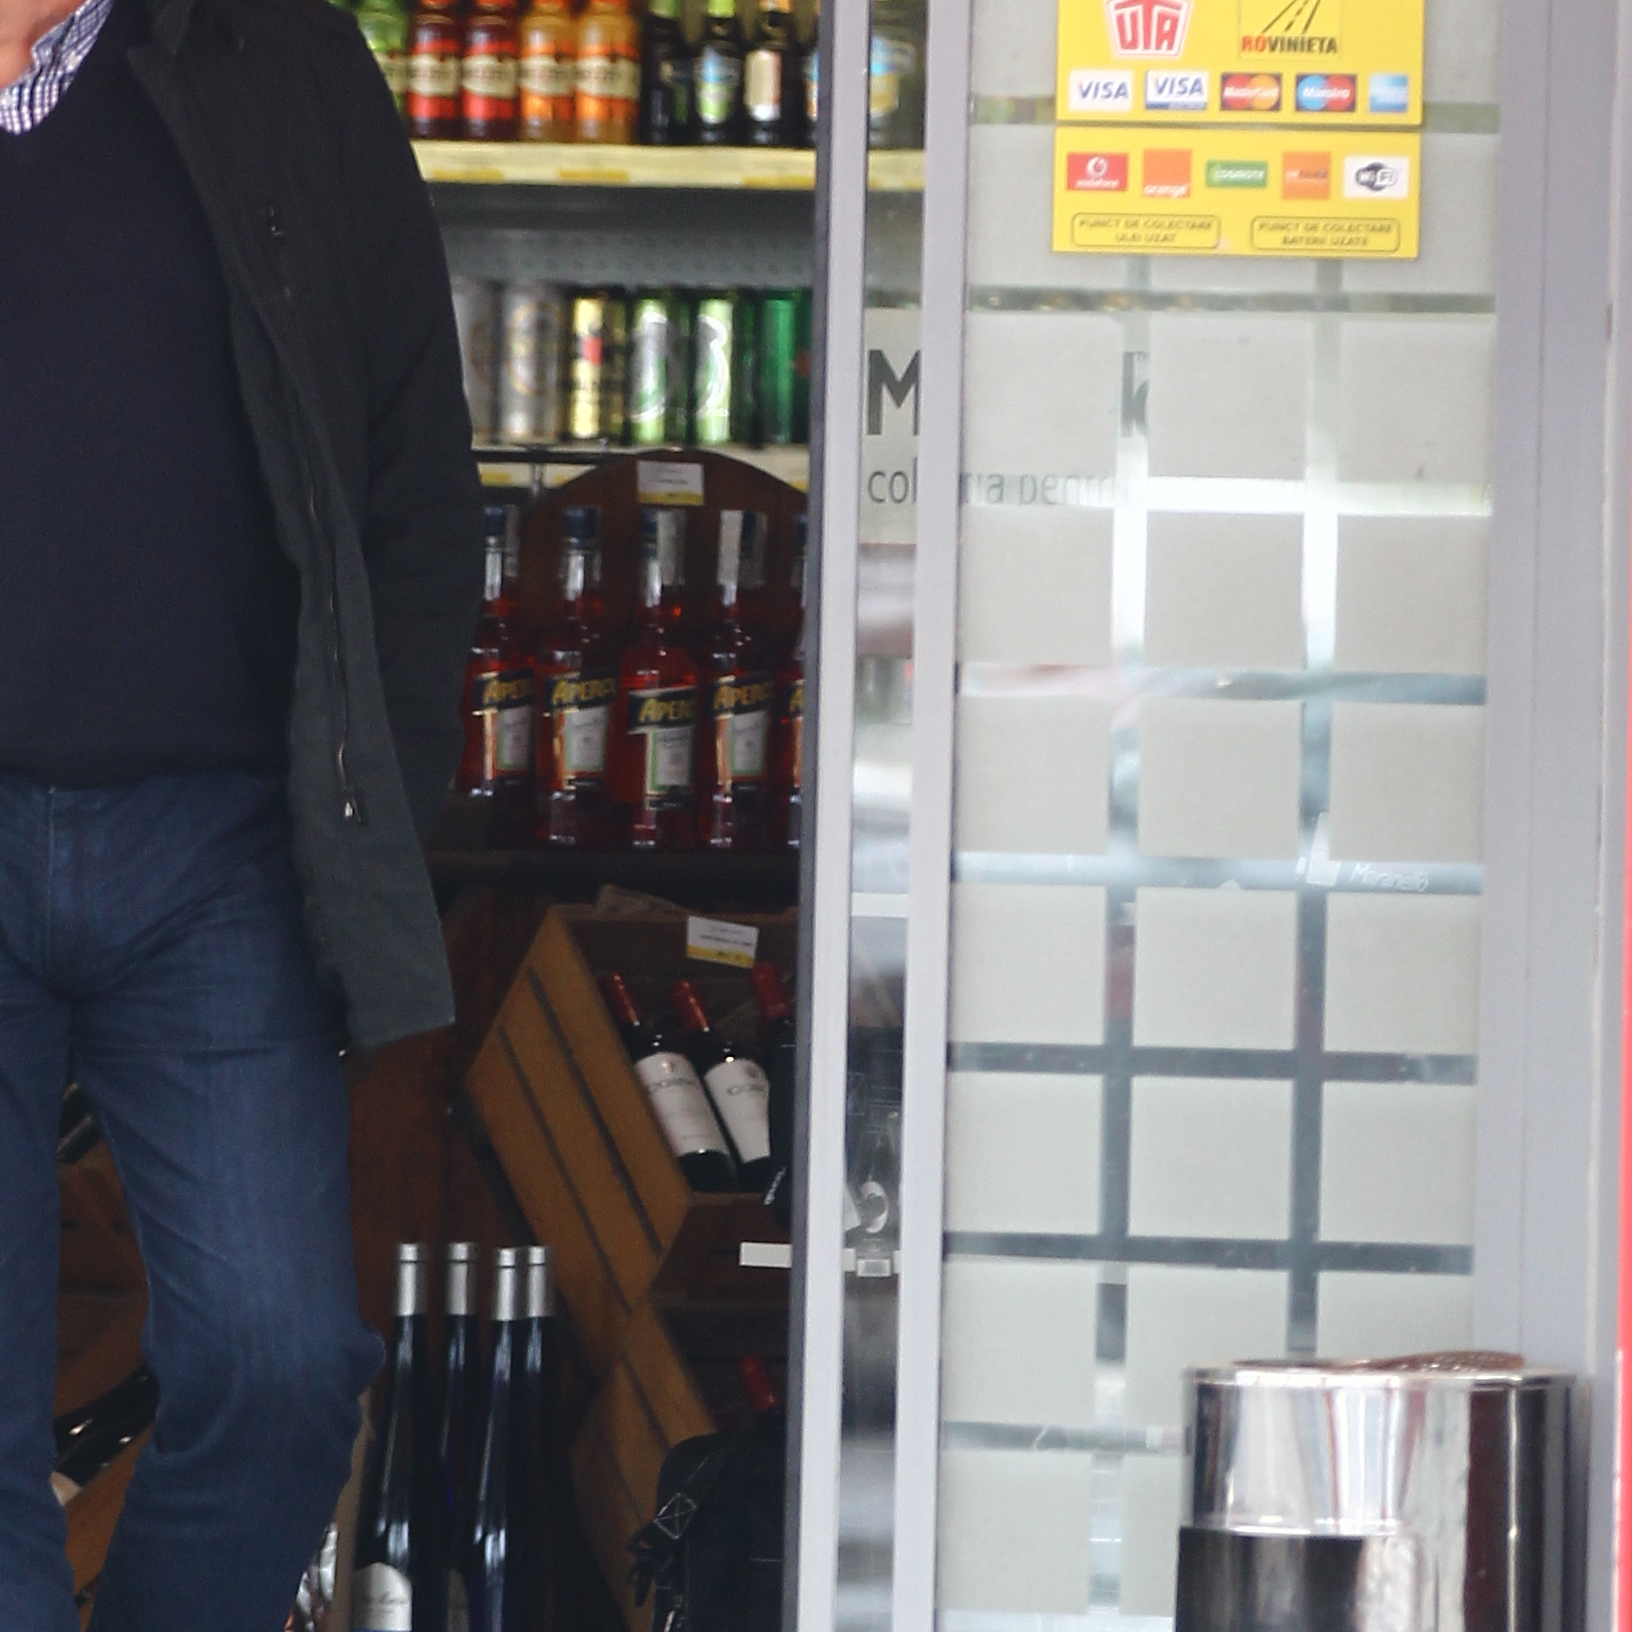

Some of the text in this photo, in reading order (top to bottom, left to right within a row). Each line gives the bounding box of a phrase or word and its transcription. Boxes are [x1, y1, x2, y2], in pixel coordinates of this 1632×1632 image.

[1241, 35, 1339, 54] ROVINIETA
[1079, 80, 1128, 99] VISA
[1155, 76, 1204, 96] VISA
